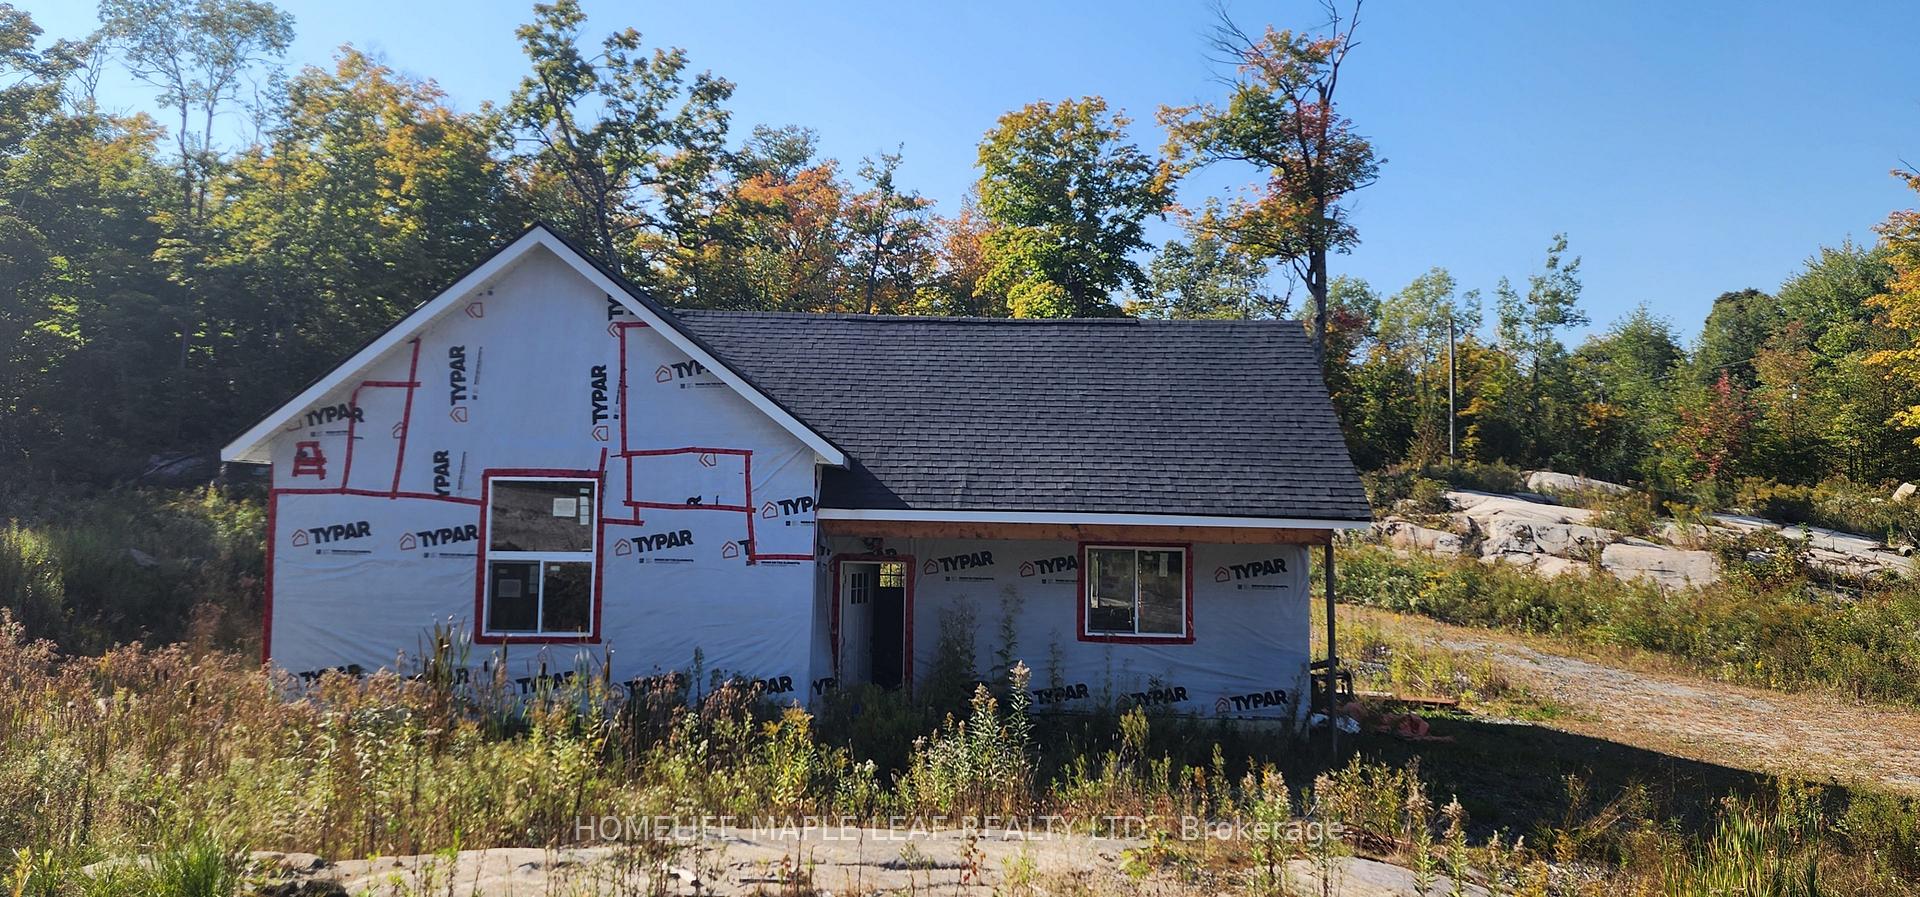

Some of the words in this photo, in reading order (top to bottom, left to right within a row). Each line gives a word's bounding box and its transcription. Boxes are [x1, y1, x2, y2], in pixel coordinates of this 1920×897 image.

[449, 345, 467, 405] TYPAR
[591, 364, 608, 425] TYPAR
[305, 402, 365, 426] TYPAR
[433, 450, 450, 497] YPAR
[777, 496, 816, 515] TYP
[309, 521, 371, 543] TYPAR
[416, 524, 479, 547] TYPAR
[631, 530, 693, 552] TYPAR
[938, 550, 994, 572] TYPAR
[1034, 555, 1078, 574] TYPA
[1229, 558, 1288, 580] TYPAR
[1229, 690, 1288, 711] TYPAR
